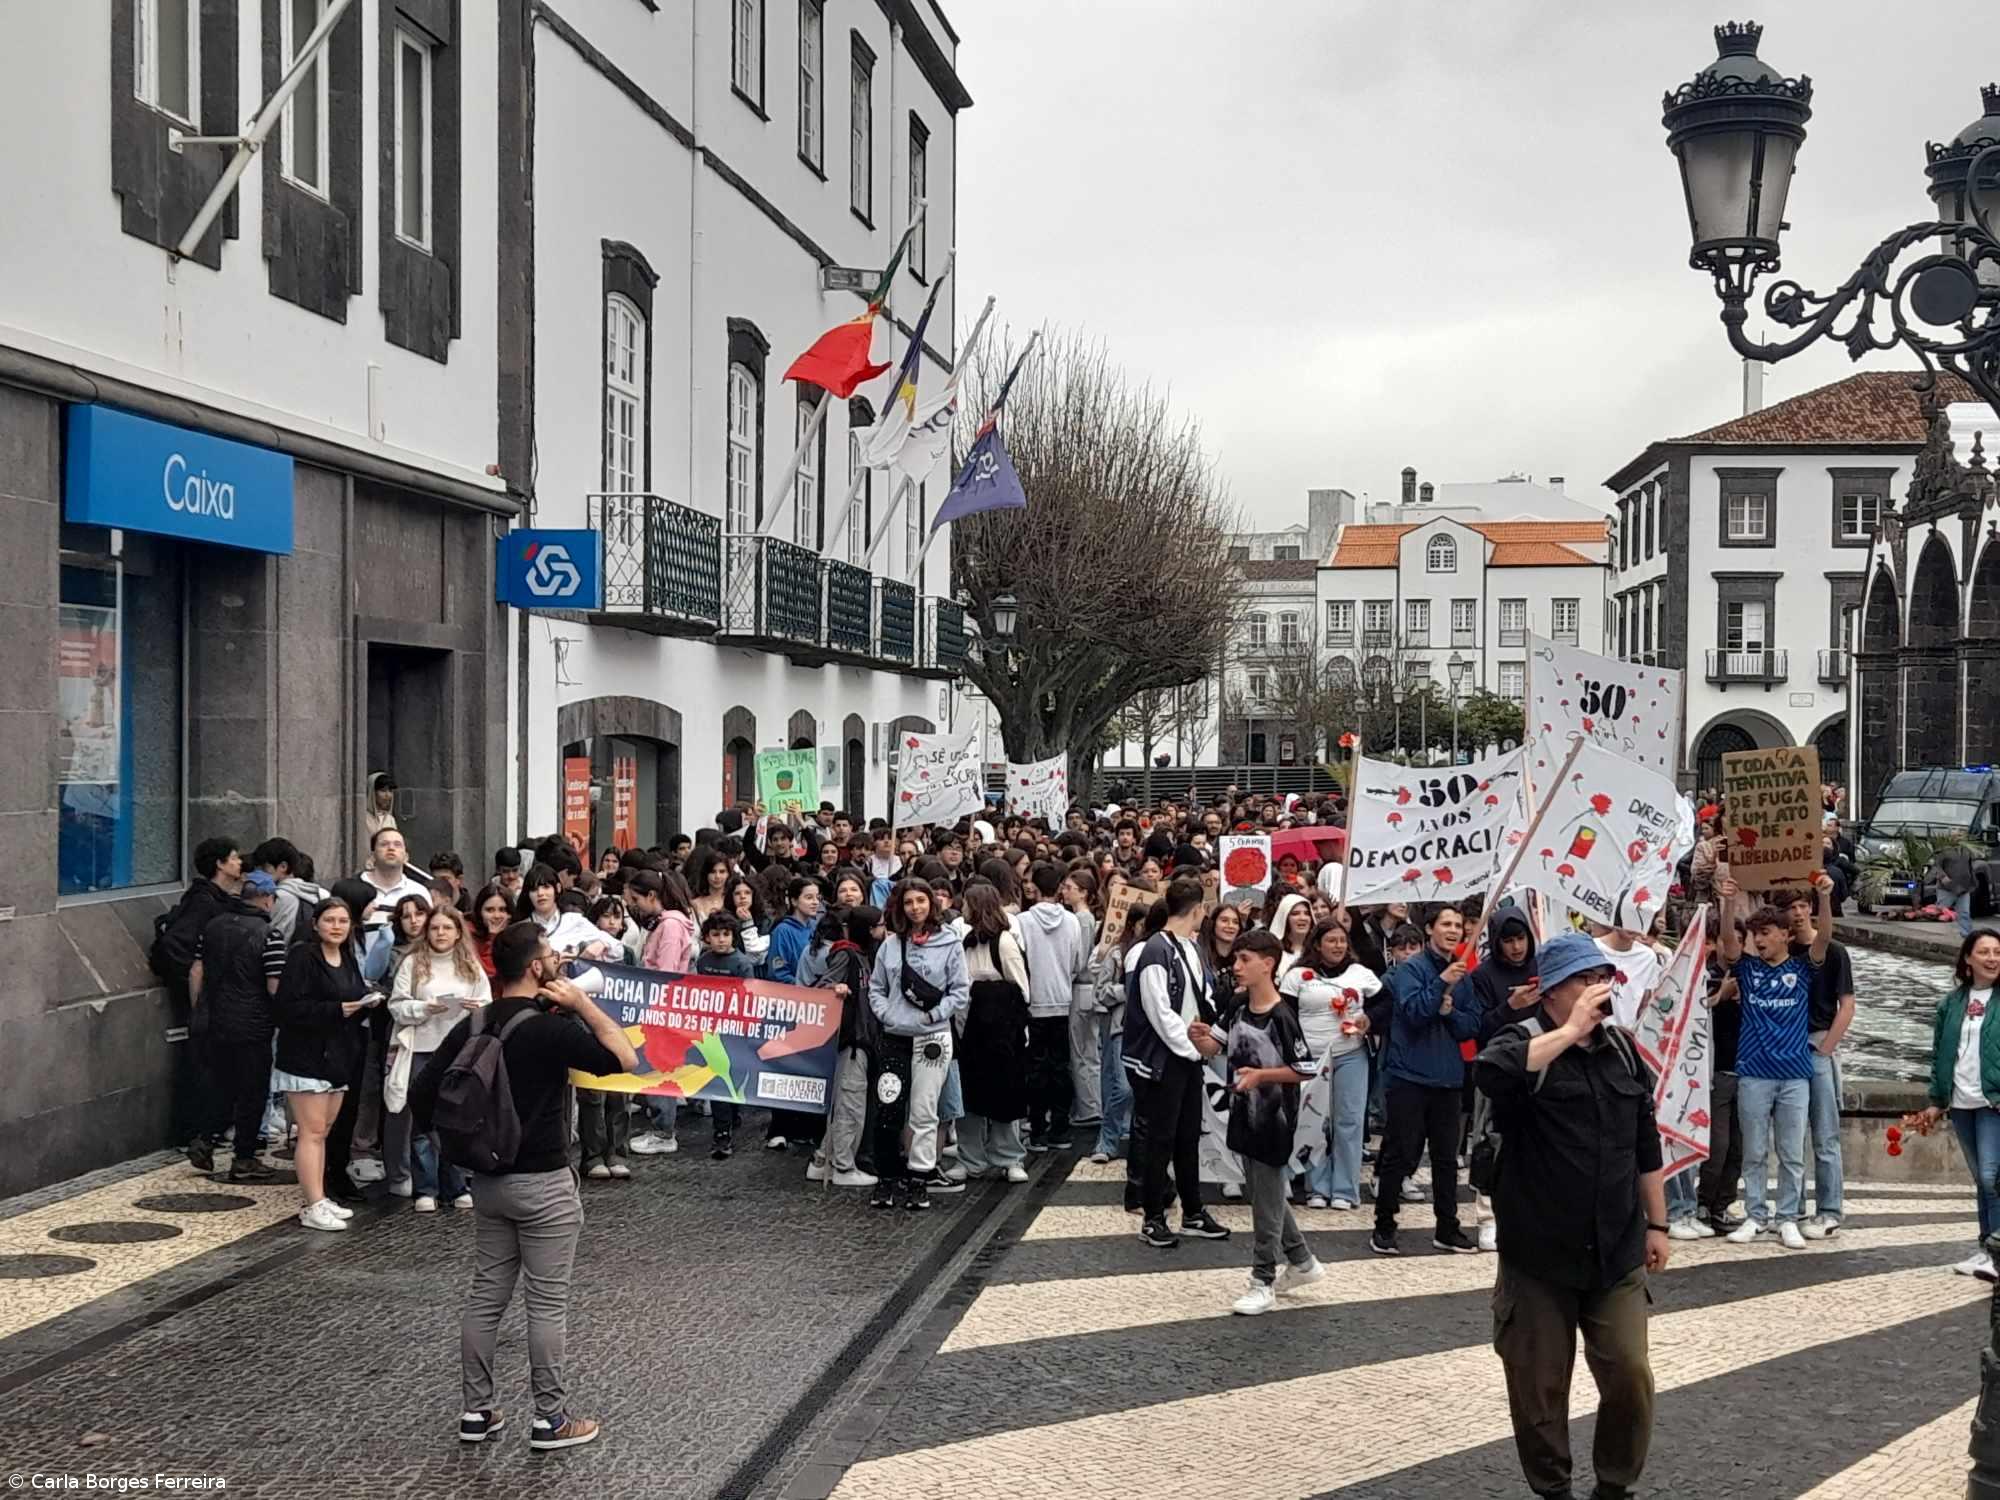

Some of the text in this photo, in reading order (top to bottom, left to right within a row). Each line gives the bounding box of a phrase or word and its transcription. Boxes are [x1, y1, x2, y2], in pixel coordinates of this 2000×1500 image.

[163, 453, 235, 520] Caixa
[1579, 680, 1627, 720] 50
[1726, 754, 1806, 775] TODA A
[1418, 773, 1479, 808] 50
[1725, 770, 1809, 793] TENTATIVA
[1729, 788, 1809, 810] DE FUGA
[1743, 810, 1768, 826] UM
[1775, 805, 1809, 823] ATO
[1761, 824, 1780, 839] DE
[1730, 845, 1812, 866] LIBERDADE
[587, 976, 827, 1027] RCHA DE ELOGIO À LIBERDADE
[621, 1006, 787, 1041] 50 ANOS DO 25 DE ABRIL DE 1974
